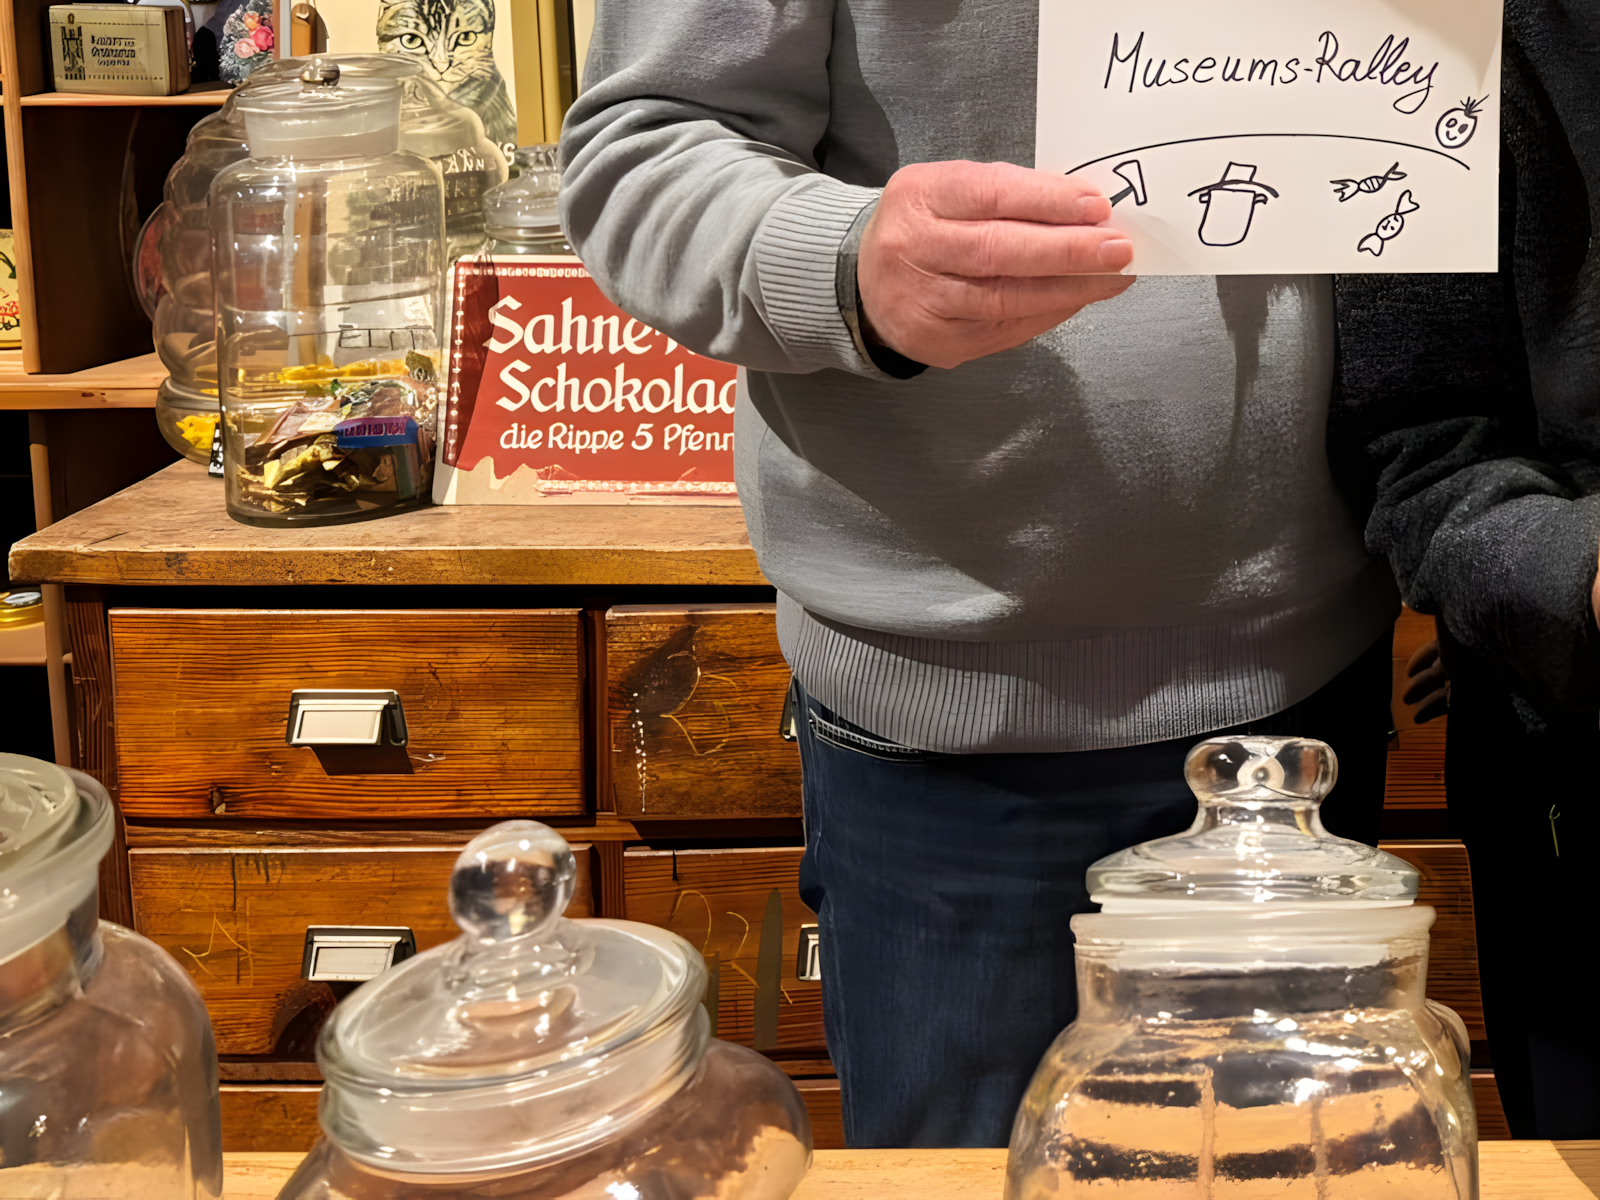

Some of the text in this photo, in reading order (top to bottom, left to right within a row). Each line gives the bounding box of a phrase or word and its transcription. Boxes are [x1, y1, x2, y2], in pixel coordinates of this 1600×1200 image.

[1104, 31, 1439, 114] Museums-Ralley
[500, 422, 543, 450] die
[547, 422, 624, 455] Rippe
[631, 423, 654, 451] 5
